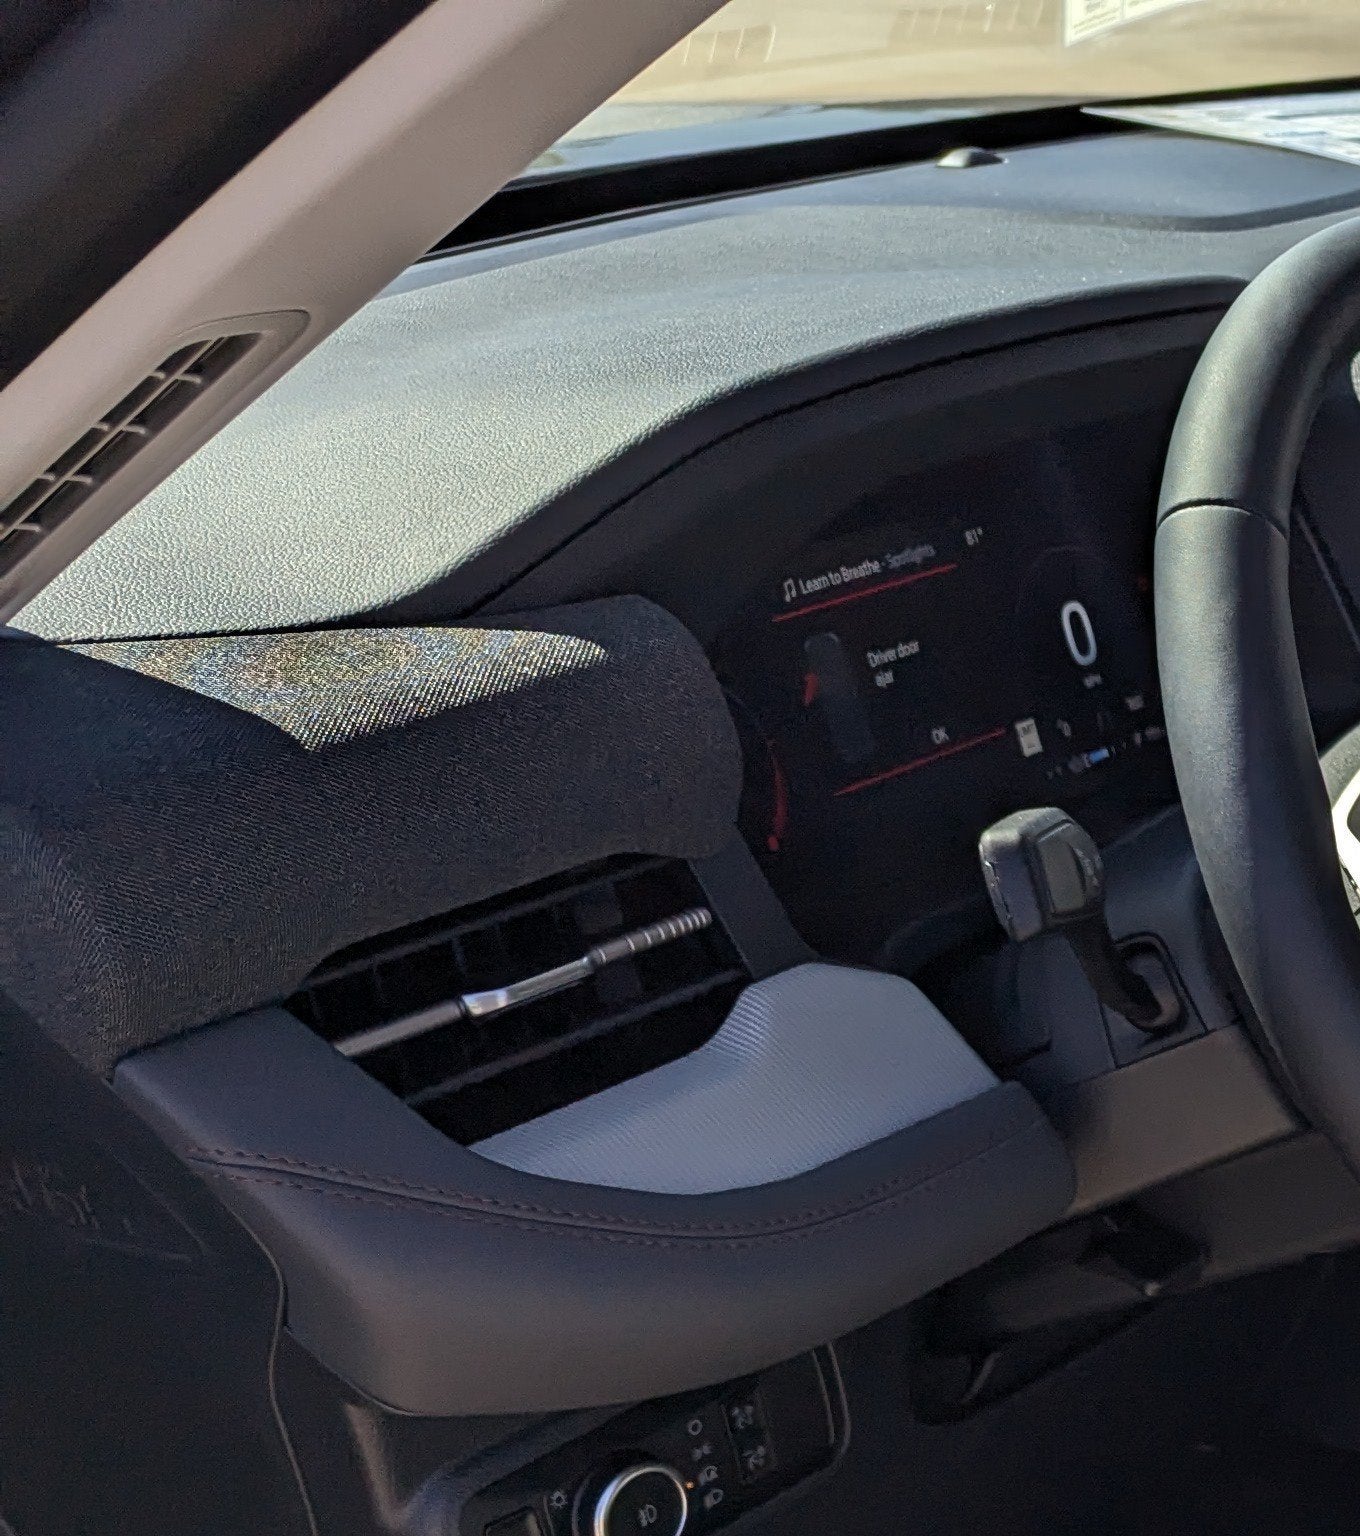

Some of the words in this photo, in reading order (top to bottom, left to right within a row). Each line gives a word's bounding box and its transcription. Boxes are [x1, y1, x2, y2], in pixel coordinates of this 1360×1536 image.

[799, 576, 831, 594] Learn
[828, 571, 842, 586] to
[839, 559, 882, 582] Breathe
[1061, 600, 1098, 666] 0
